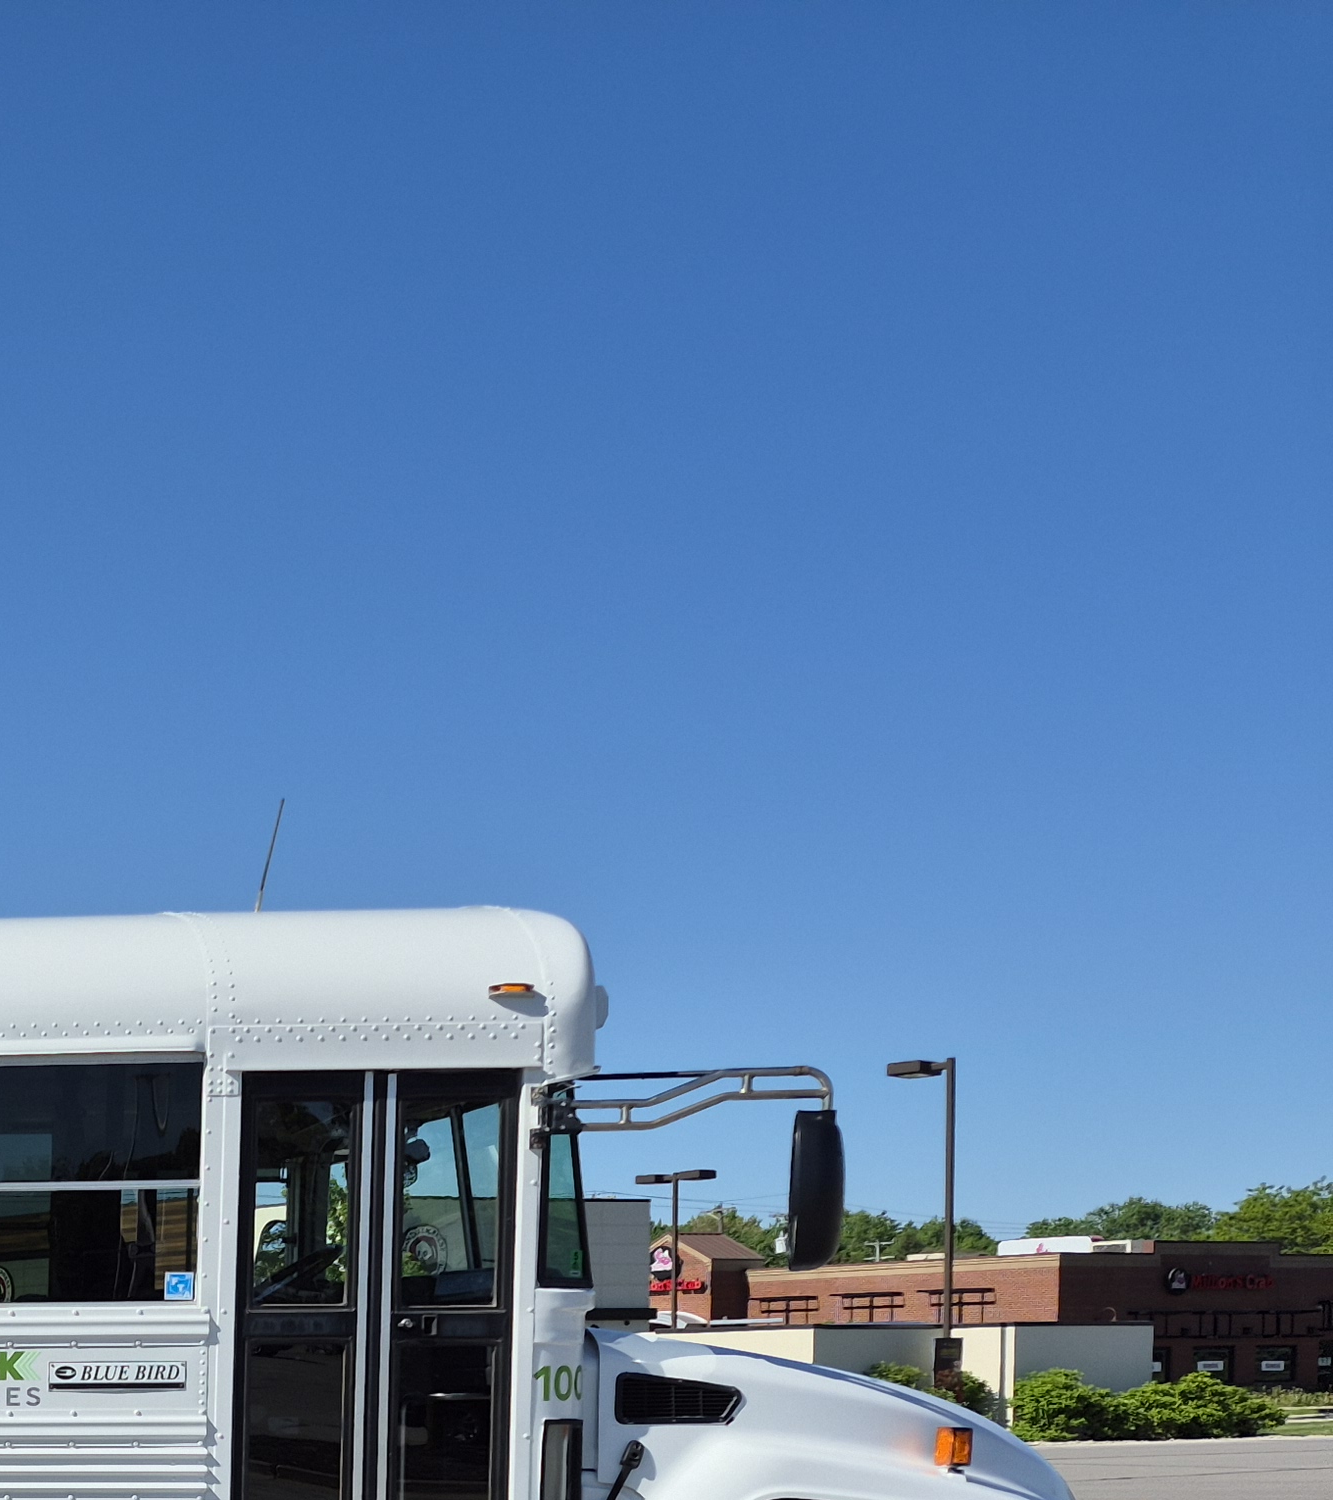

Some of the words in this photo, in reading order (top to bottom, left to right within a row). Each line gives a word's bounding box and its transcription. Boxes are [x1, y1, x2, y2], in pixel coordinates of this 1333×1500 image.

[1246, 1273, 1276, 1290] Crab
[81, 1364, 130, 1381] BLUE
[135, 1364, 180, 1381] BIRD
